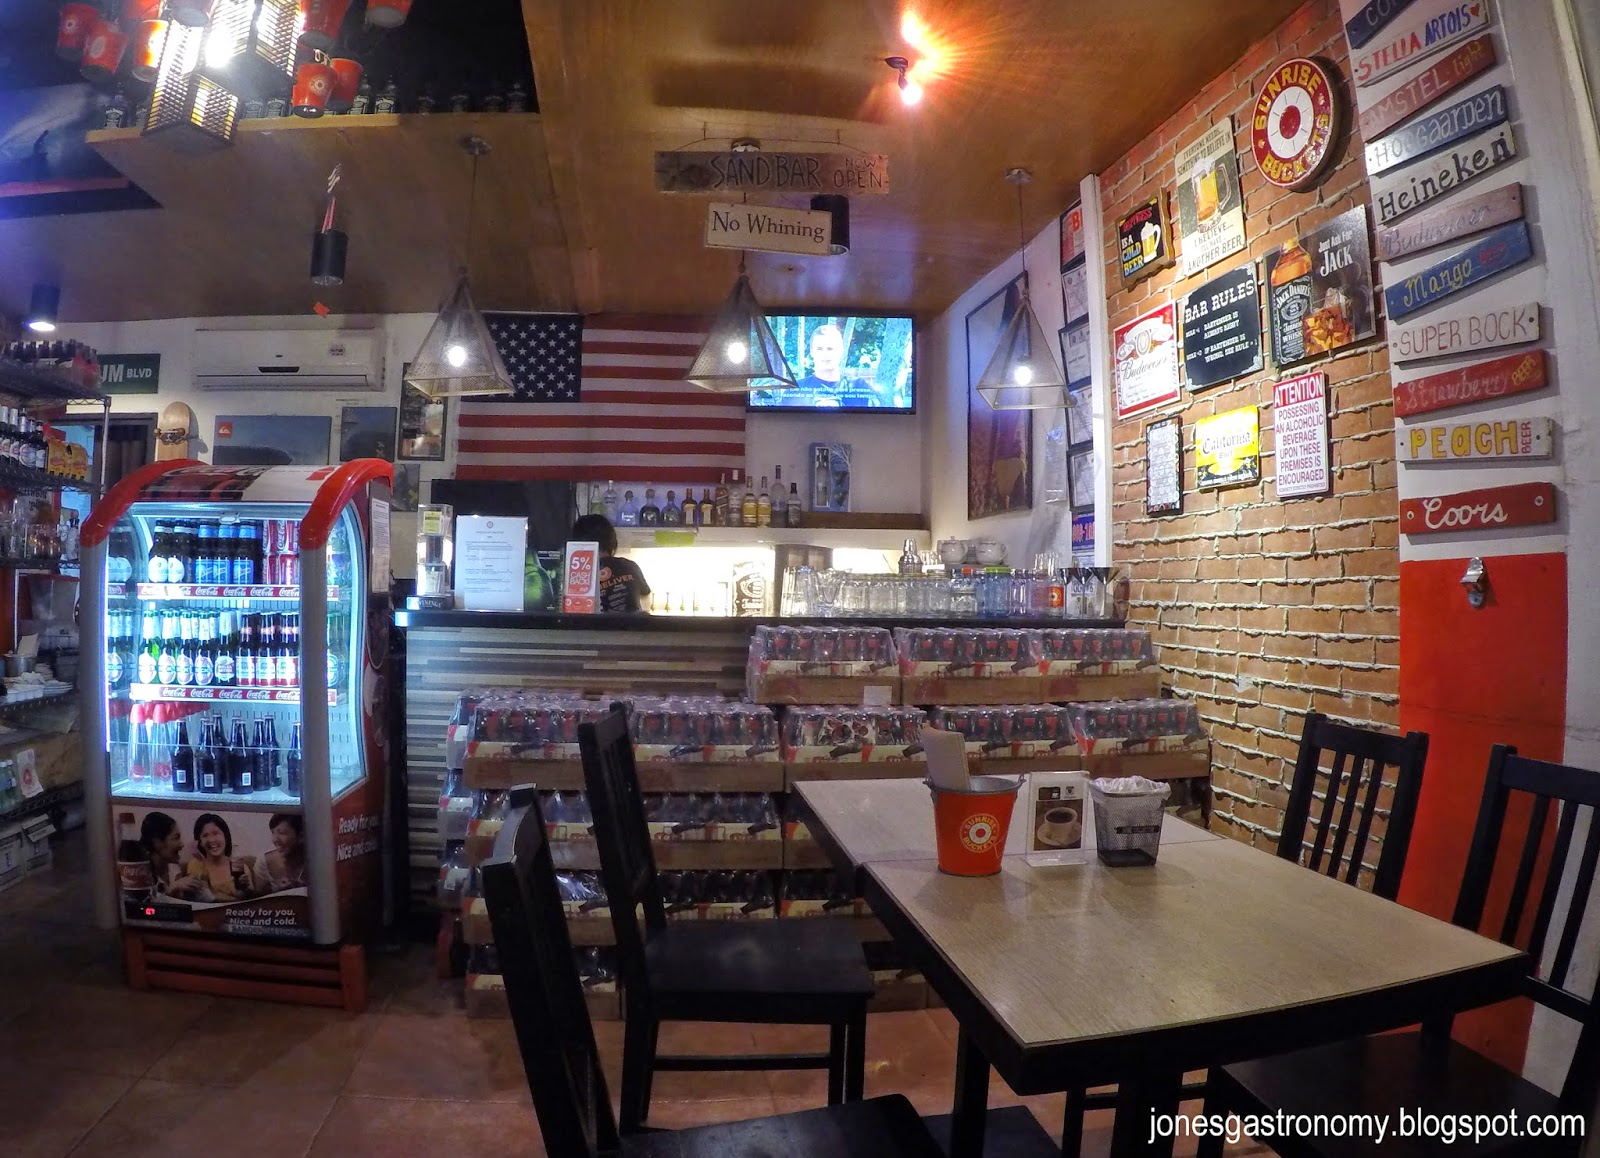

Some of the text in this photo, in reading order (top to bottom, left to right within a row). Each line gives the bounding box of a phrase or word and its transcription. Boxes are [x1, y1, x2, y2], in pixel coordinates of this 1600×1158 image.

[1358, 3, 1472, 81] STELLA ARTOIS
[1254, 64, 1321, 131] SUNRISE
[1369, 68, 1450, 128] AMSTEL
[845, 157, 877, 168] NOW
[833, 169, 883, 188] OPEN
[1378, 131, 1513, 221] Heineken
[712, 210, 825, 243] No Whining
[1122, 241, 1141, 262] COLD
[1187, 234, 1242, 272] ANOTHER BEER
[1318, 240, 1330, 253] Just
[1330, 235, 1342, 246] Ask
[1123, 255, 1145, 277] BEER
[1320, 246, 1354, 277] JACK
[1403, 259, 1473, 307] Mango
[1185, 279, 1255, 324] BAR RULES
[1400, 307, 1527, 356] SUPER BOCK
[126, 368, 152, 379] BLVD
[1274, 374, 1323, 408] ATTENTION
[1405, 370, 1508, 410] Strawberry
[1278, 401, 1320, 420] POSSESSING
[1275, 413, 1324, 434] AN ALCOHOLIC
[1202, 431, 1250, 454] California
[1282, 428, 1317, 446] BEVERAGE
[1520, 421, 1532, 454] BEER
[1280, 441, 1321, 460] UPON THESE
[1280, 455, 1321, 473] PREMISES IS
[1278, 468, 1324, 486] ENCOURAGED
[1423, 498, 1509, 530] Coors
[571, 556, 591, 570] 5%
[570, 571, 591, 579] CASH
[338, 814, 358, 834] Ready
[964, 816, 997, 829] SUNRISE
[337, 843, 352, 861] Nice
[225, 908, 296, 918] Ready for you.
[229, 917, 297, 925] Nice and cold.
